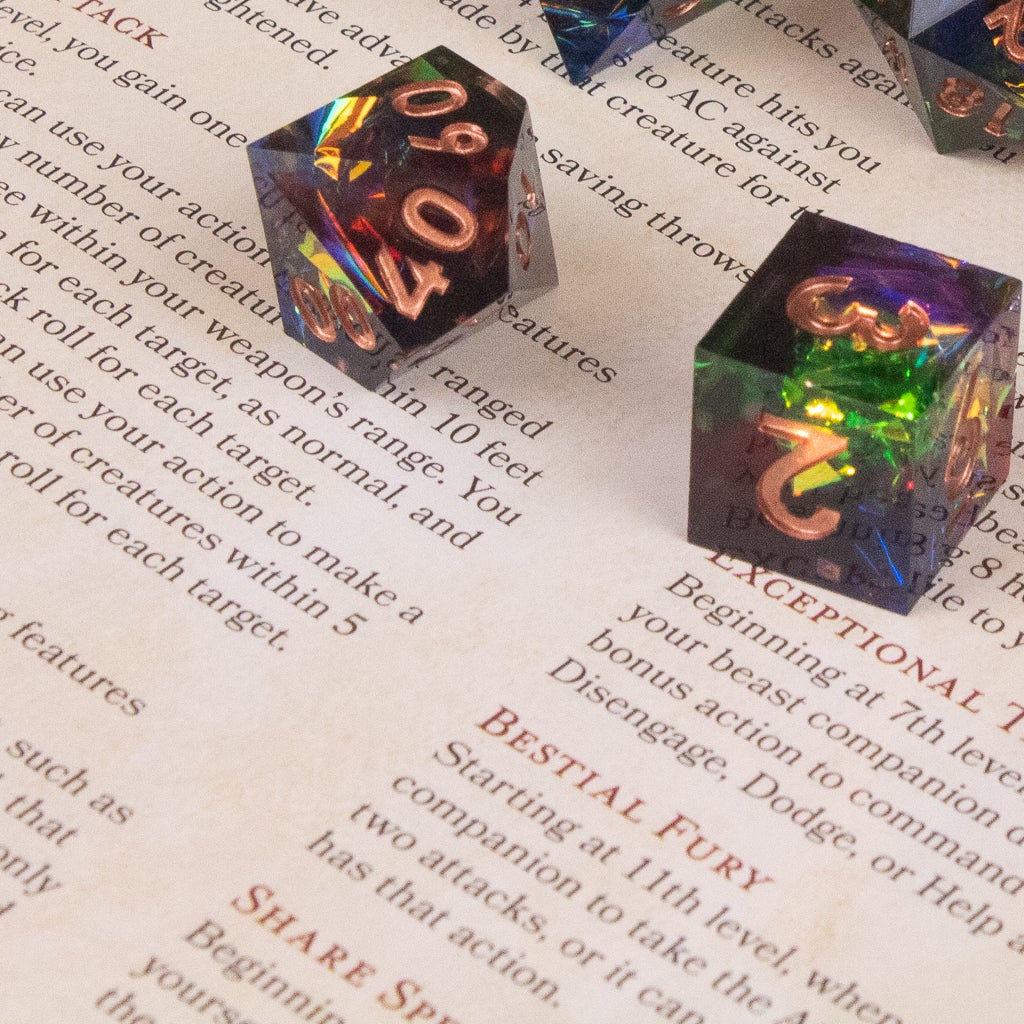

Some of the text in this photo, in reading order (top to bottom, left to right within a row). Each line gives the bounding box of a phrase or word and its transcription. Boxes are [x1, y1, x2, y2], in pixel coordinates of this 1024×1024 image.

[375, 187, 480, 321] 40
[27, 361, 425, 625] use your action to make a
[54, 488, 109, 526] for
[106, 527, 185, 583] each
[186, 578, 288, 652] target.
[664, 571, 847, 689] Beginning
[843, 683, 885, 709] at
[889, 699, 946, 746] 7th
[306, 829, 373, 881] has
[374, 876, 450, 930] that
[432, 740, 582, 843] Starting
[578, 837, 620, 864] at
[625, 857, 701, 916] 11th
[475, 705, 776, 893] BESTIAL FURY
[230, 883, 377, 989] SHARE
